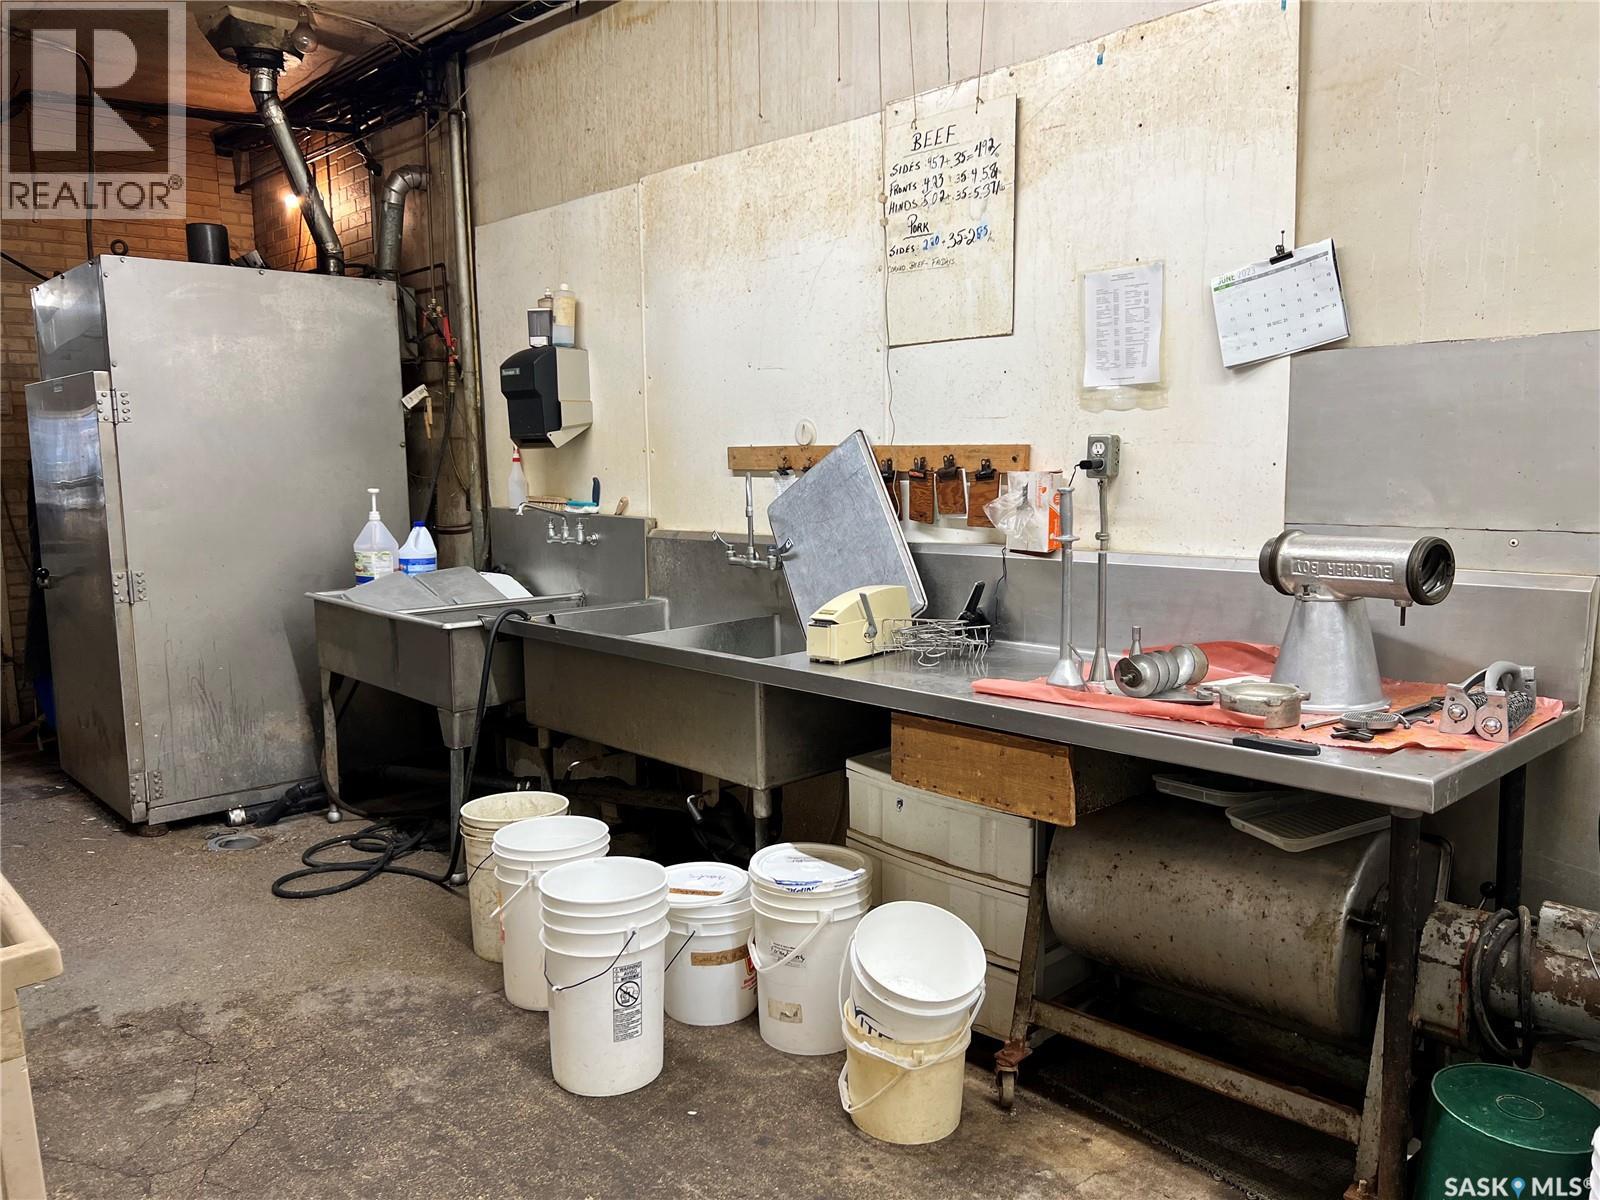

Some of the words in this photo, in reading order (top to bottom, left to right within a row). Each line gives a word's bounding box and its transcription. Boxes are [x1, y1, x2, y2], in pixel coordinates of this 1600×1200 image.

[911, 124, 957, 152] BEEF
[890, 161, 921, 177] SIDES
[889, 180, 917, 197] FRONTS
[889, 244, 915, 257] SIDES
[1217, 275, 1235, 286] JUNE
[1237, 266, 1256, 279] 2023
[1297, 559, 1320, 575] BOY
[1328, 561, 1393, 578] BUTCHER
